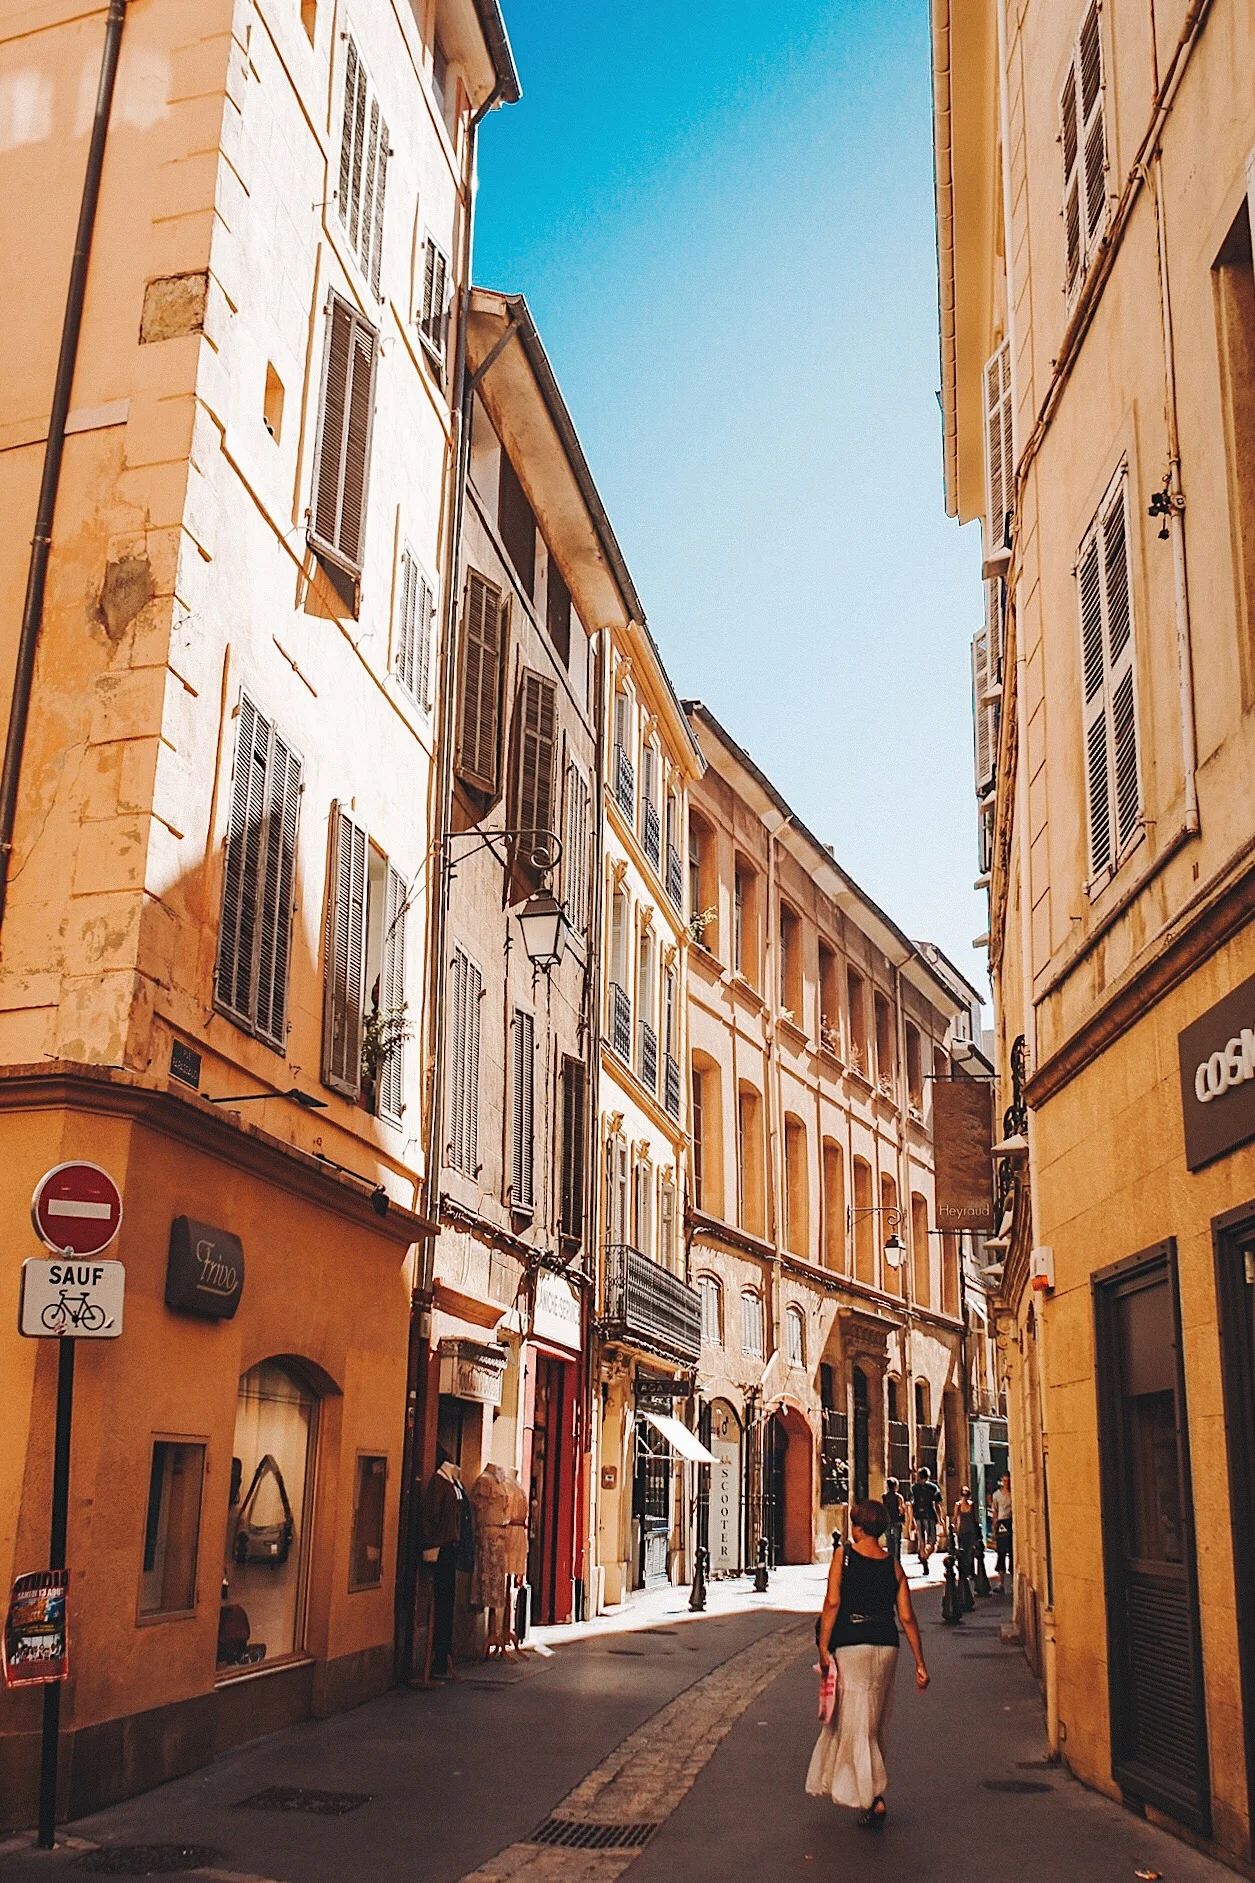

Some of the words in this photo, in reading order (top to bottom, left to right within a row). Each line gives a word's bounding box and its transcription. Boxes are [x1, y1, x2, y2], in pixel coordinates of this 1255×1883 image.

[939, 1203, 990, 1220] Heyraud
[48, 1264, 104, 1287] SAUF
[720, 1468, 730, 1557] SCOOTER
